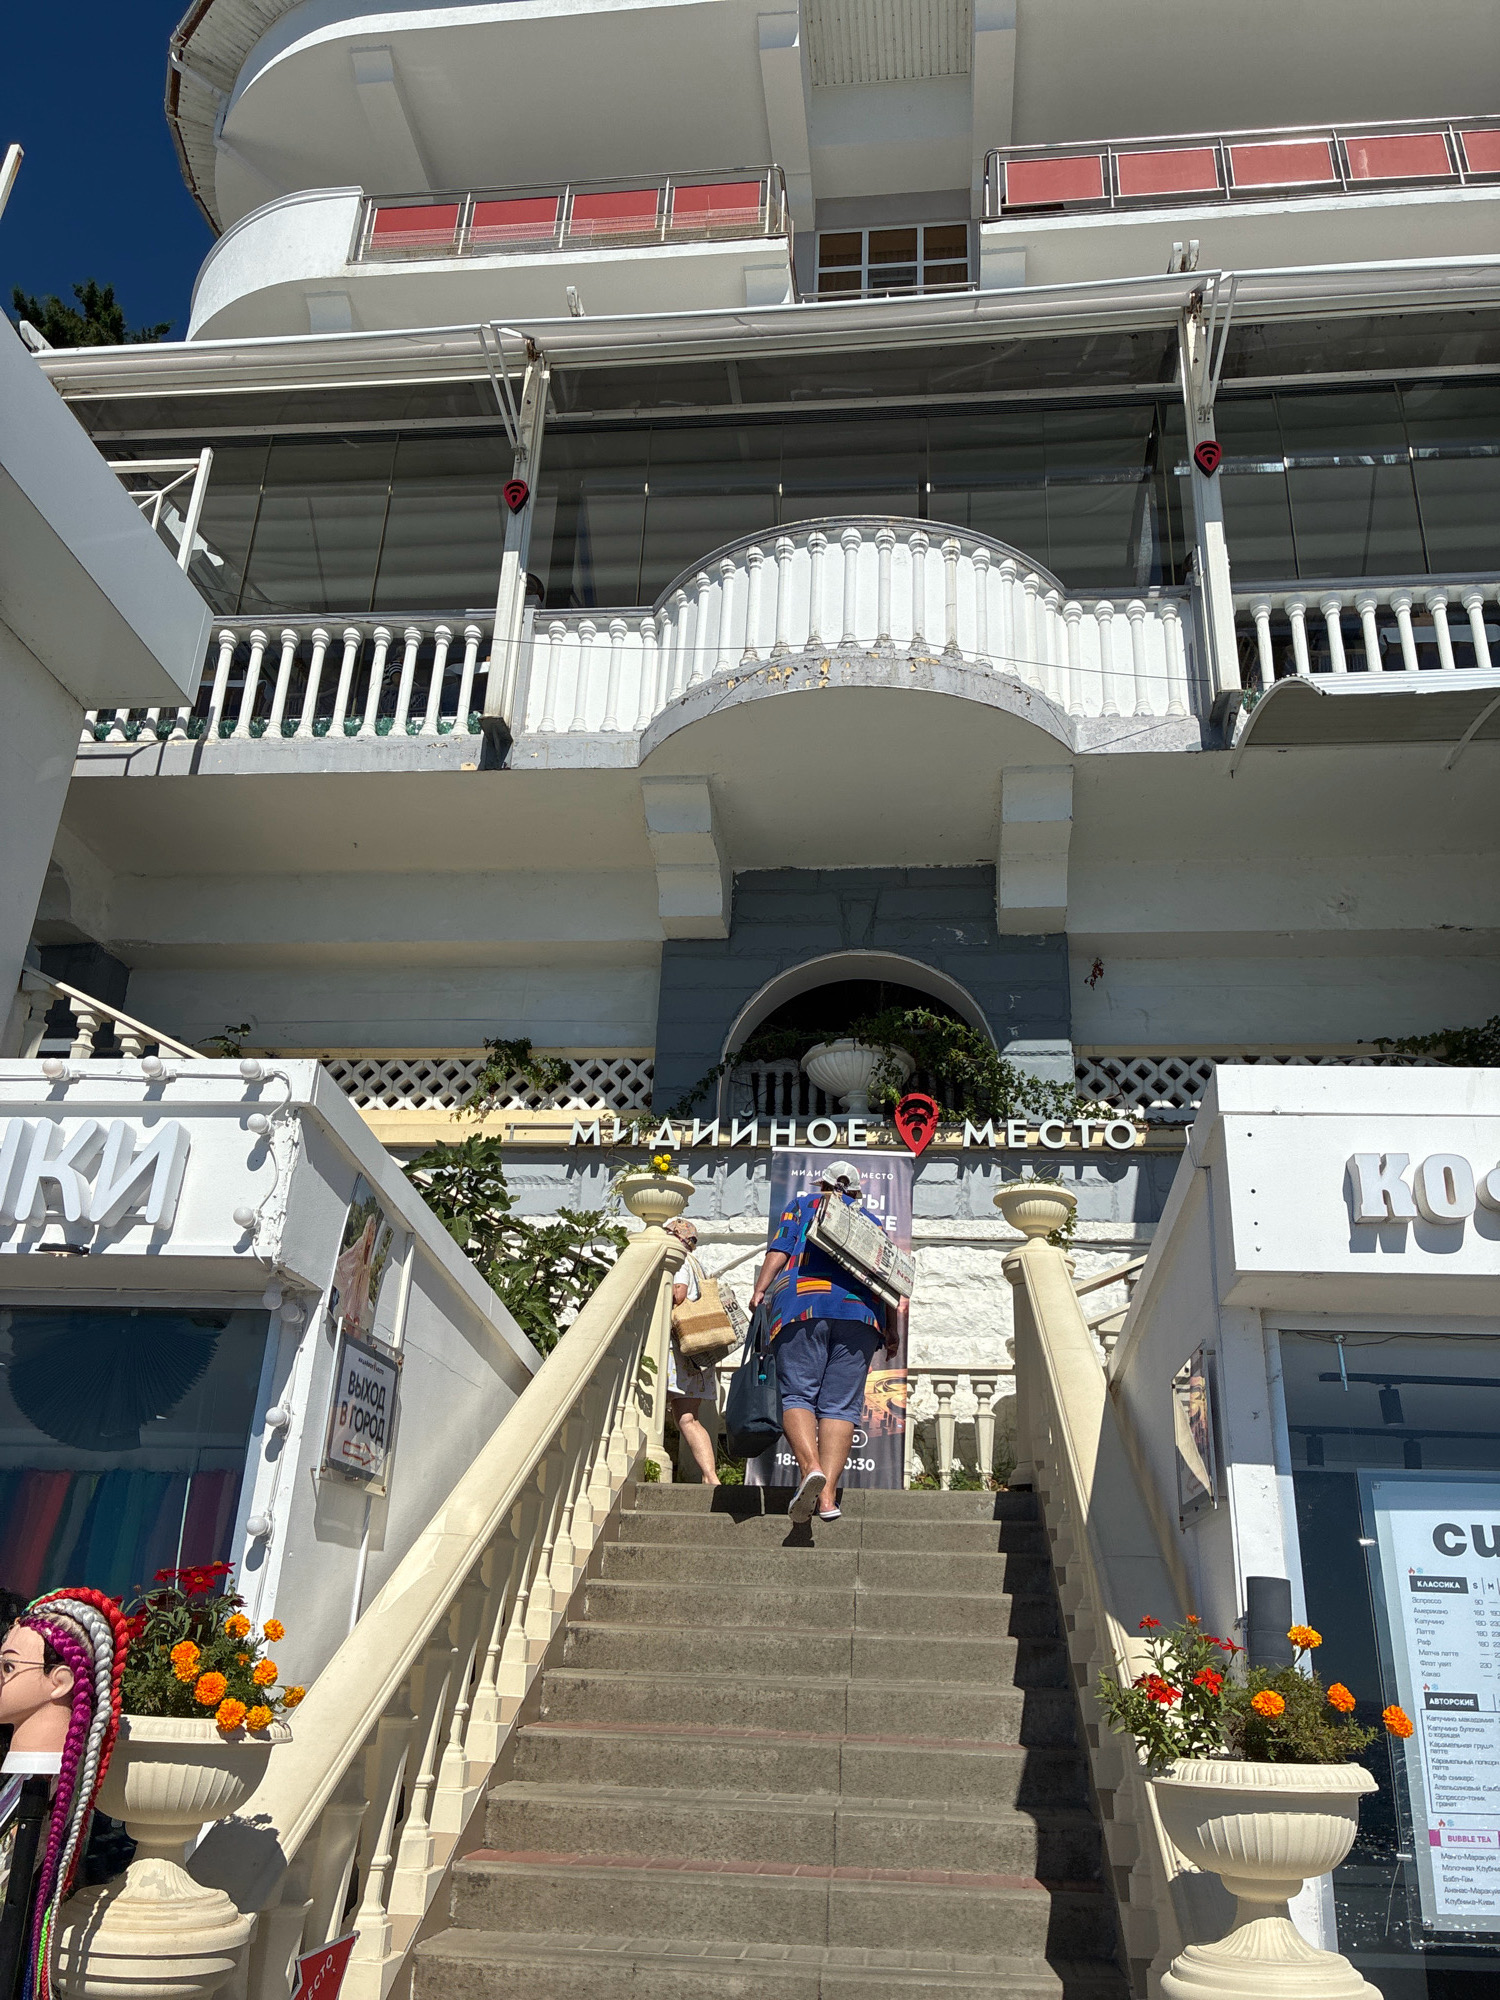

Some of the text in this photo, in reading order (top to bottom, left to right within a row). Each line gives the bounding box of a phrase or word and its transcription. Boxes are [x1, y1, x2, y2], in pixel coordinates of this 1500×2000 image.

[569, 1109, 1137, 1150] МИДИЙНОЕ МЕСТО
[0, 1117, 191, 1230] КИ
[861, 1171, 894, 1180] МЕСТО
[348, 1370, 386, 1415] ВЫХОД
[339, 1401, 385, 1448] В ГОРОД
[1416, 1580, 1461, 1589] КЛАССИКА
[1472, 1582, 1479, 1590] S
[1429, 1697, 1475, 1707] АВТОРСКИЕ
[303, 1954, 334, 2000] ЕСТО
